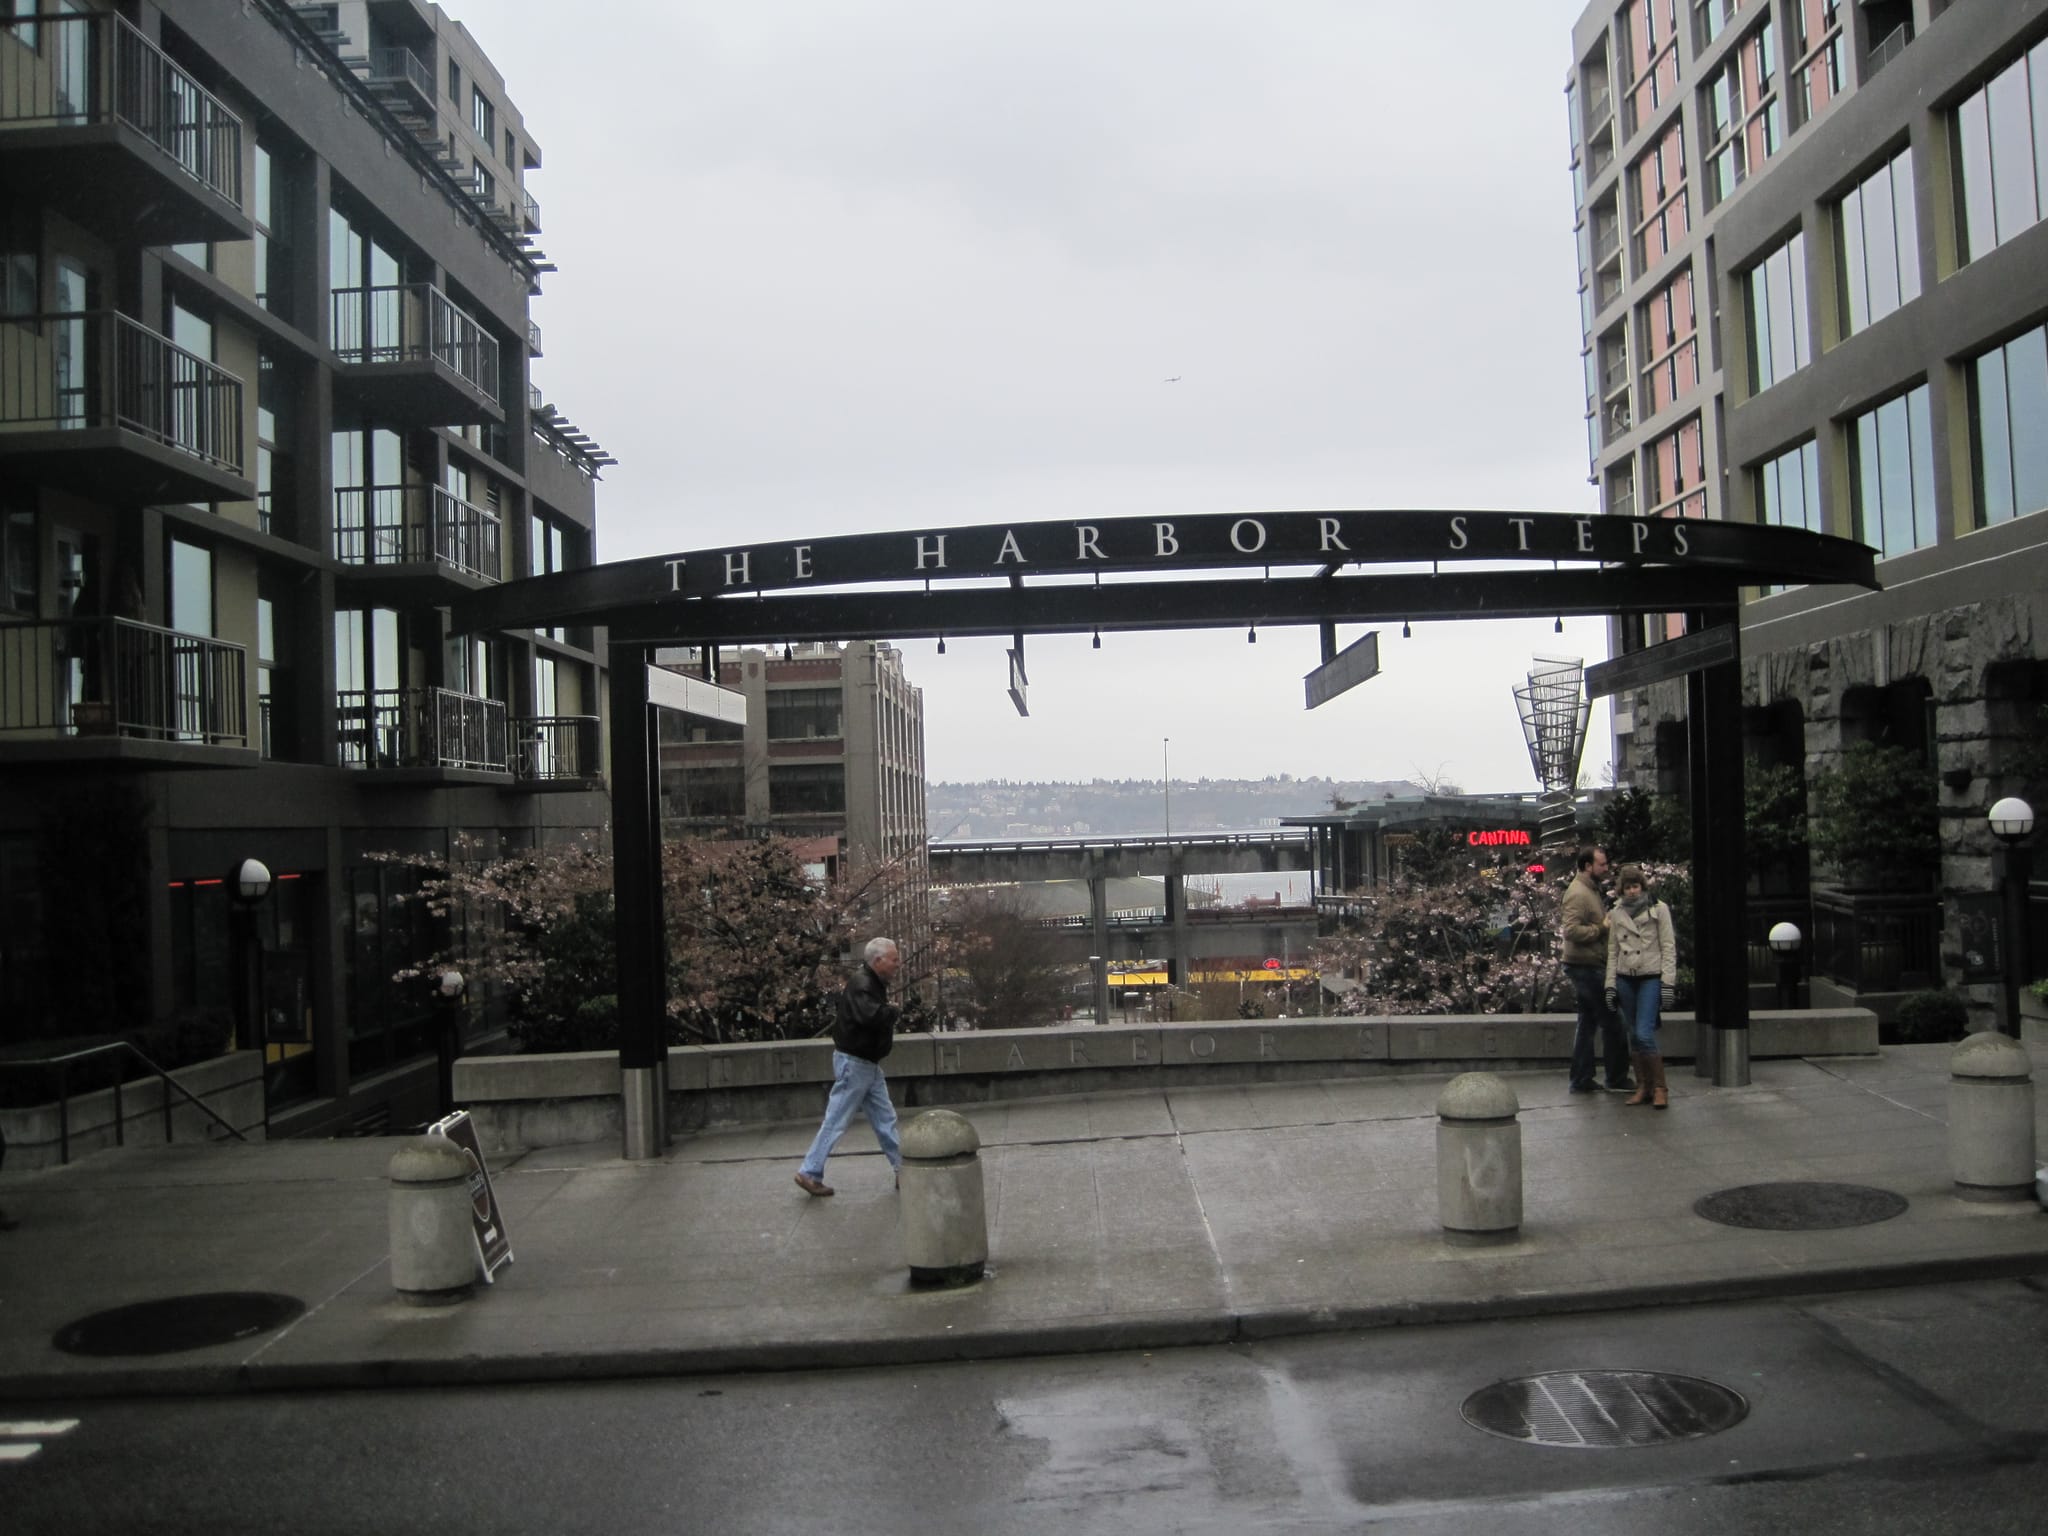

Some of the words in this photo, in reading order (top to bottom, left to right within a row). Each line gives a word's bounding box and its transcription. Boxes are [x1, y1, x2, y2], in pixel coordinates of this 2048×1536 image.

[664, 546, 814, 592] THE
[914, 517, 1351, 570] HARBOR
[1449, 516, 1689, 557] STEPS
[1468, 829, 1531, 846] CANTINA
[710, 1051, 799, 1084] TH
[938, 1032, 1281, 1070] HARBOR
[1359, 1026, 1555, 1058] STEP
